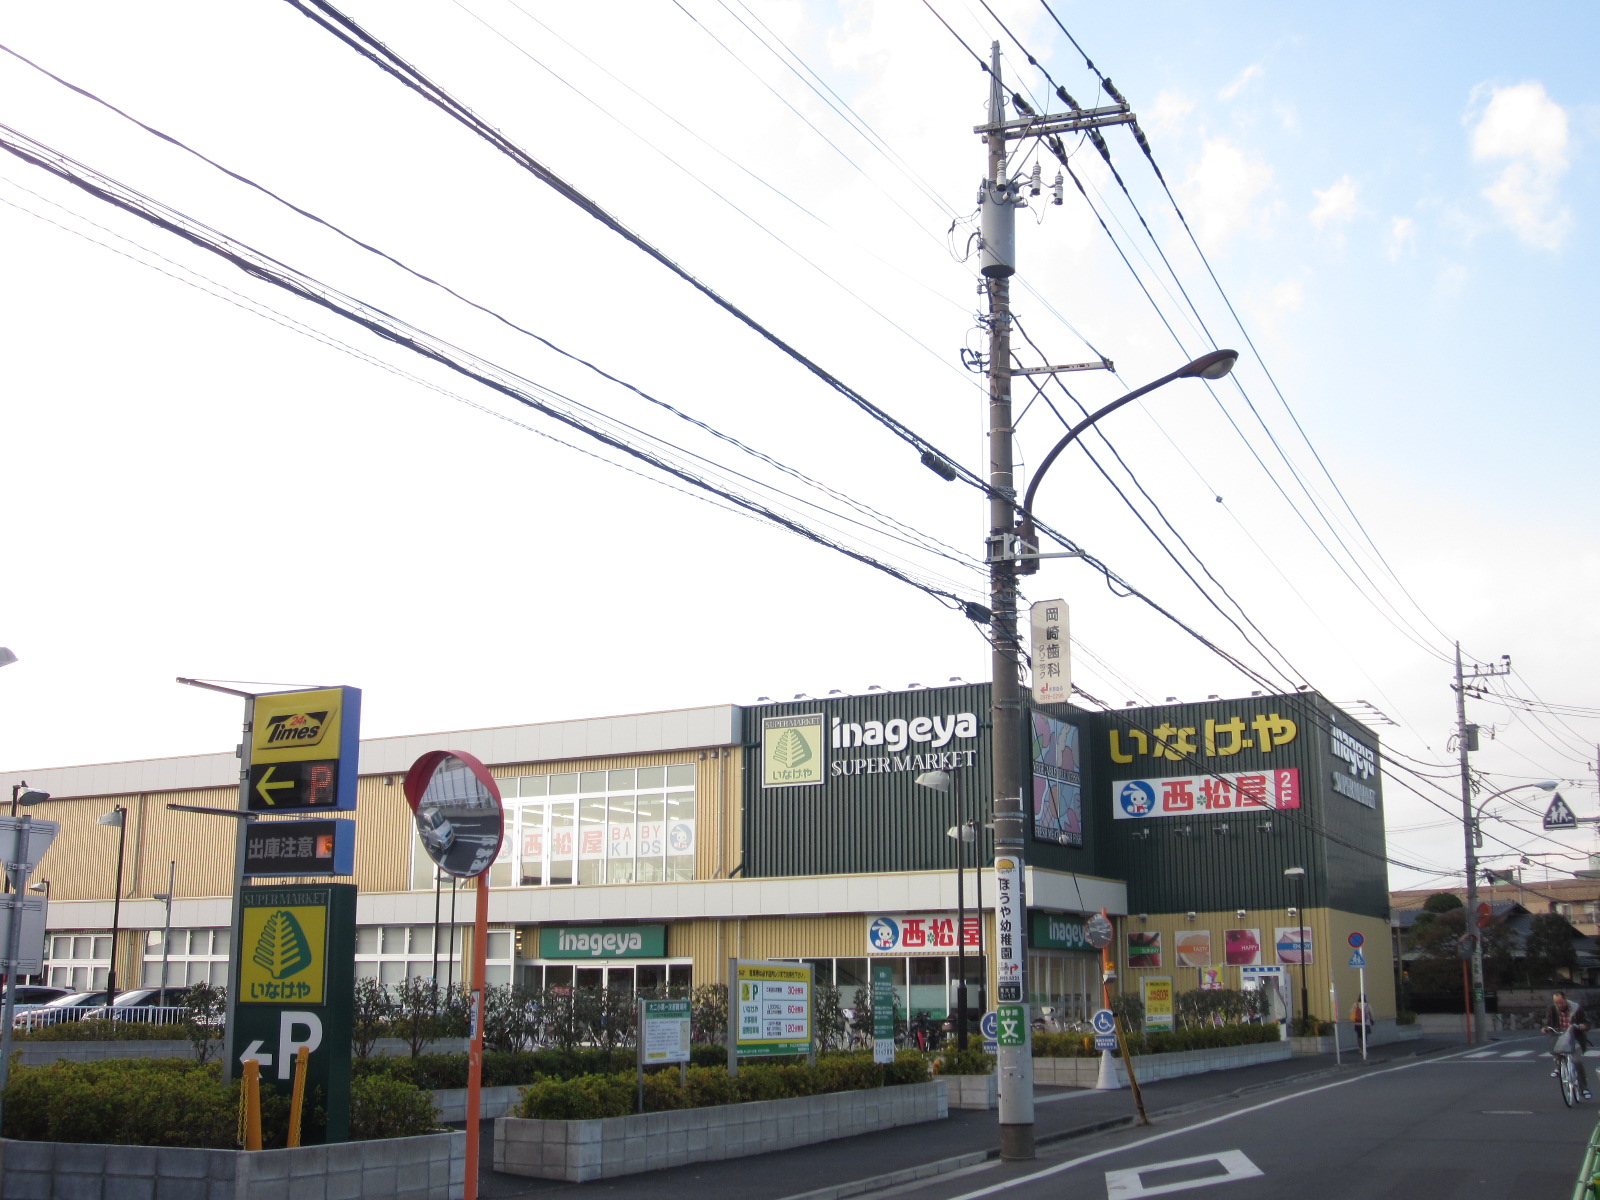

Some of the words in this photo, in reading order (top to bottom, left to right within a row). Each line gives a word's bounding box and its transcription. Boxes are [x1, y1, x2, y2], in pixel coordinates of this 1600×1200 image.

[267, 724, 320, 743] Times
[832, 712, 978, 752] inageya
[1109, 713, 1297, 764] いなげや
[310, 766, 333, 804] P
[1162, 775, 1267, 812] 西松屋
[524, 830, 604, 857] 西松屋
[611, 825, 661, 841] BABY
[248, 836, 314, 860] 出庫注意
[611, 839, 661, 857] KIDS
[901, 917, 980, 947] 西松屋
[999, 879, 1012, 960] ほうや幼稚園
[1049, 916, 1087, 947] inagey
[558, 929, 642, 956] inageya
[753, 985, 758, 1000] P
[1001, 1018, 1019, 1039] 文
[278, 1010, 323, 1080] P
